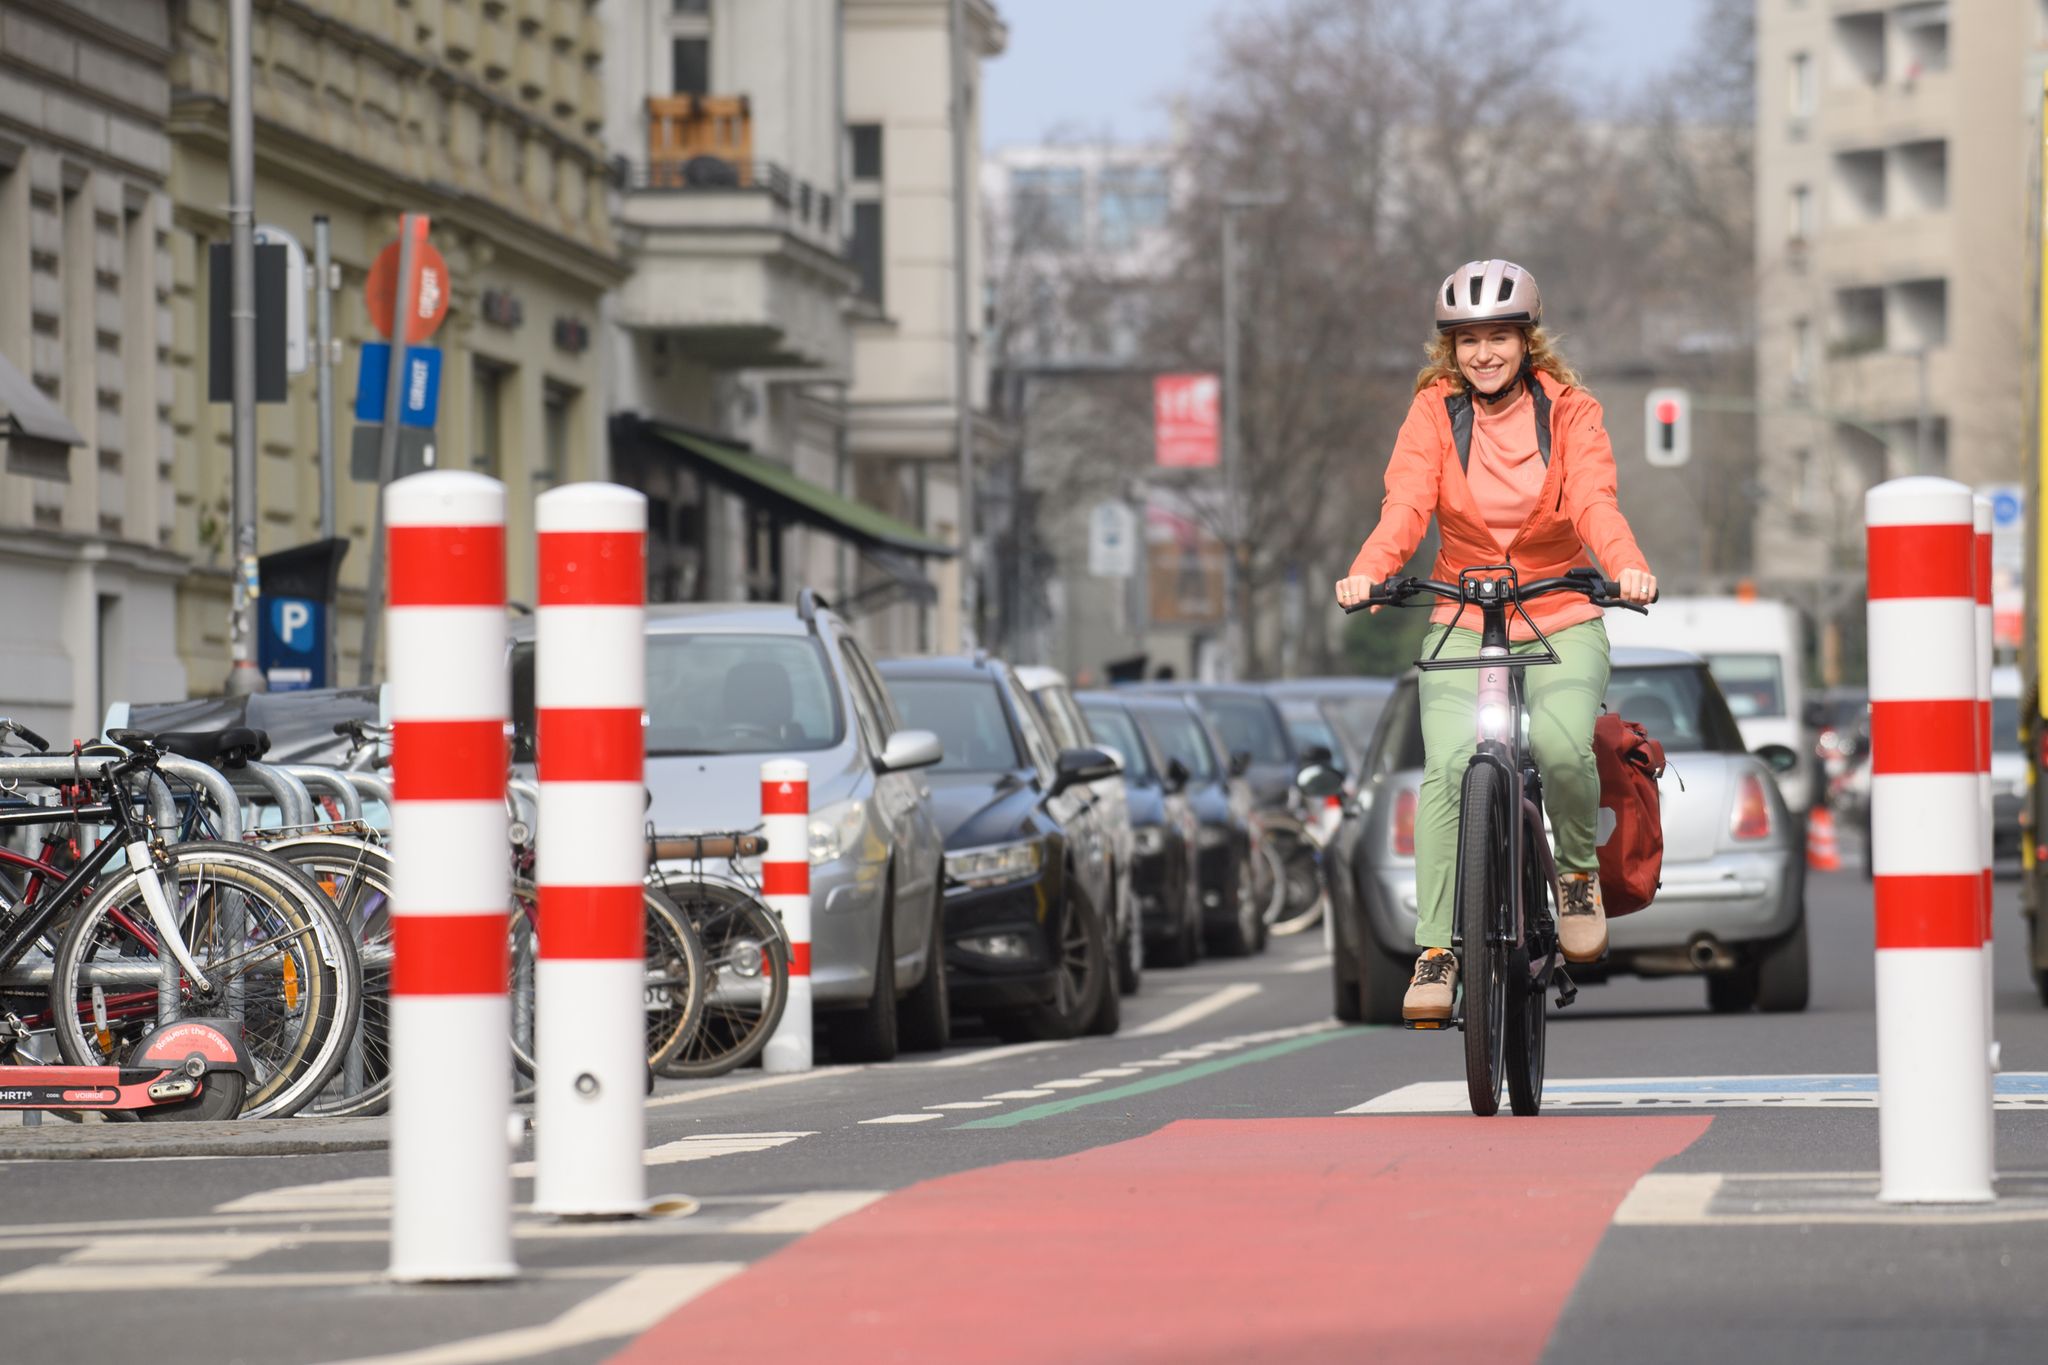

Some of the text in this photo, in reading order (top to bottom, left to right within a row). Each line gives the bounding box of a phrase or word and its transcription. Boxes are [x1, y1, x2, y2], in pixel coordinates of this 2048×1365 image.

[281, 601, 309, 643] P
[155, 1028, 188, 1051] Respect
[191, 1027, 206, 1036] the
[207, 1032, 229, 1053] street
